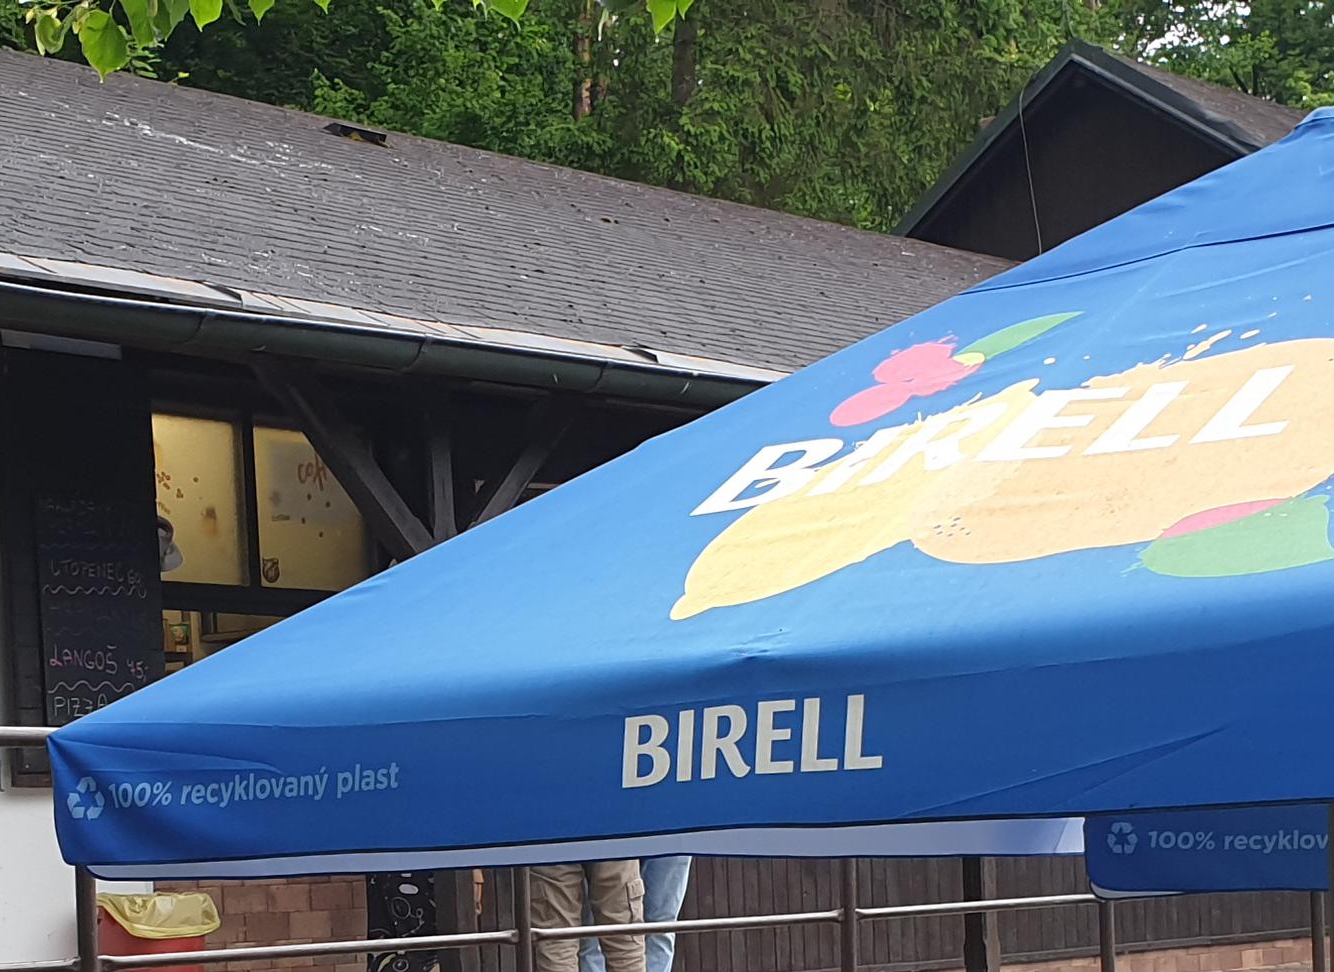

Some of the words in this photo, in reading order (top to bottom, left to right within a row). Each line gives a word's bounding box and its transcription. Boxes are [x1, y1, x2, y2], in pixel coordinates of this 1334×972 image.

[689, 365, 1297, 516] BIRELL
[49, 643, 118, 675] LANGOŠ
[622, 694, 883, 788] BIRELL
[108, 779, 173, 809] 100%
[179, 766, 328, 808] recyklovaný
[336, 761, 400, 800] plast
[1147, 829, 1216, 851] 100%
